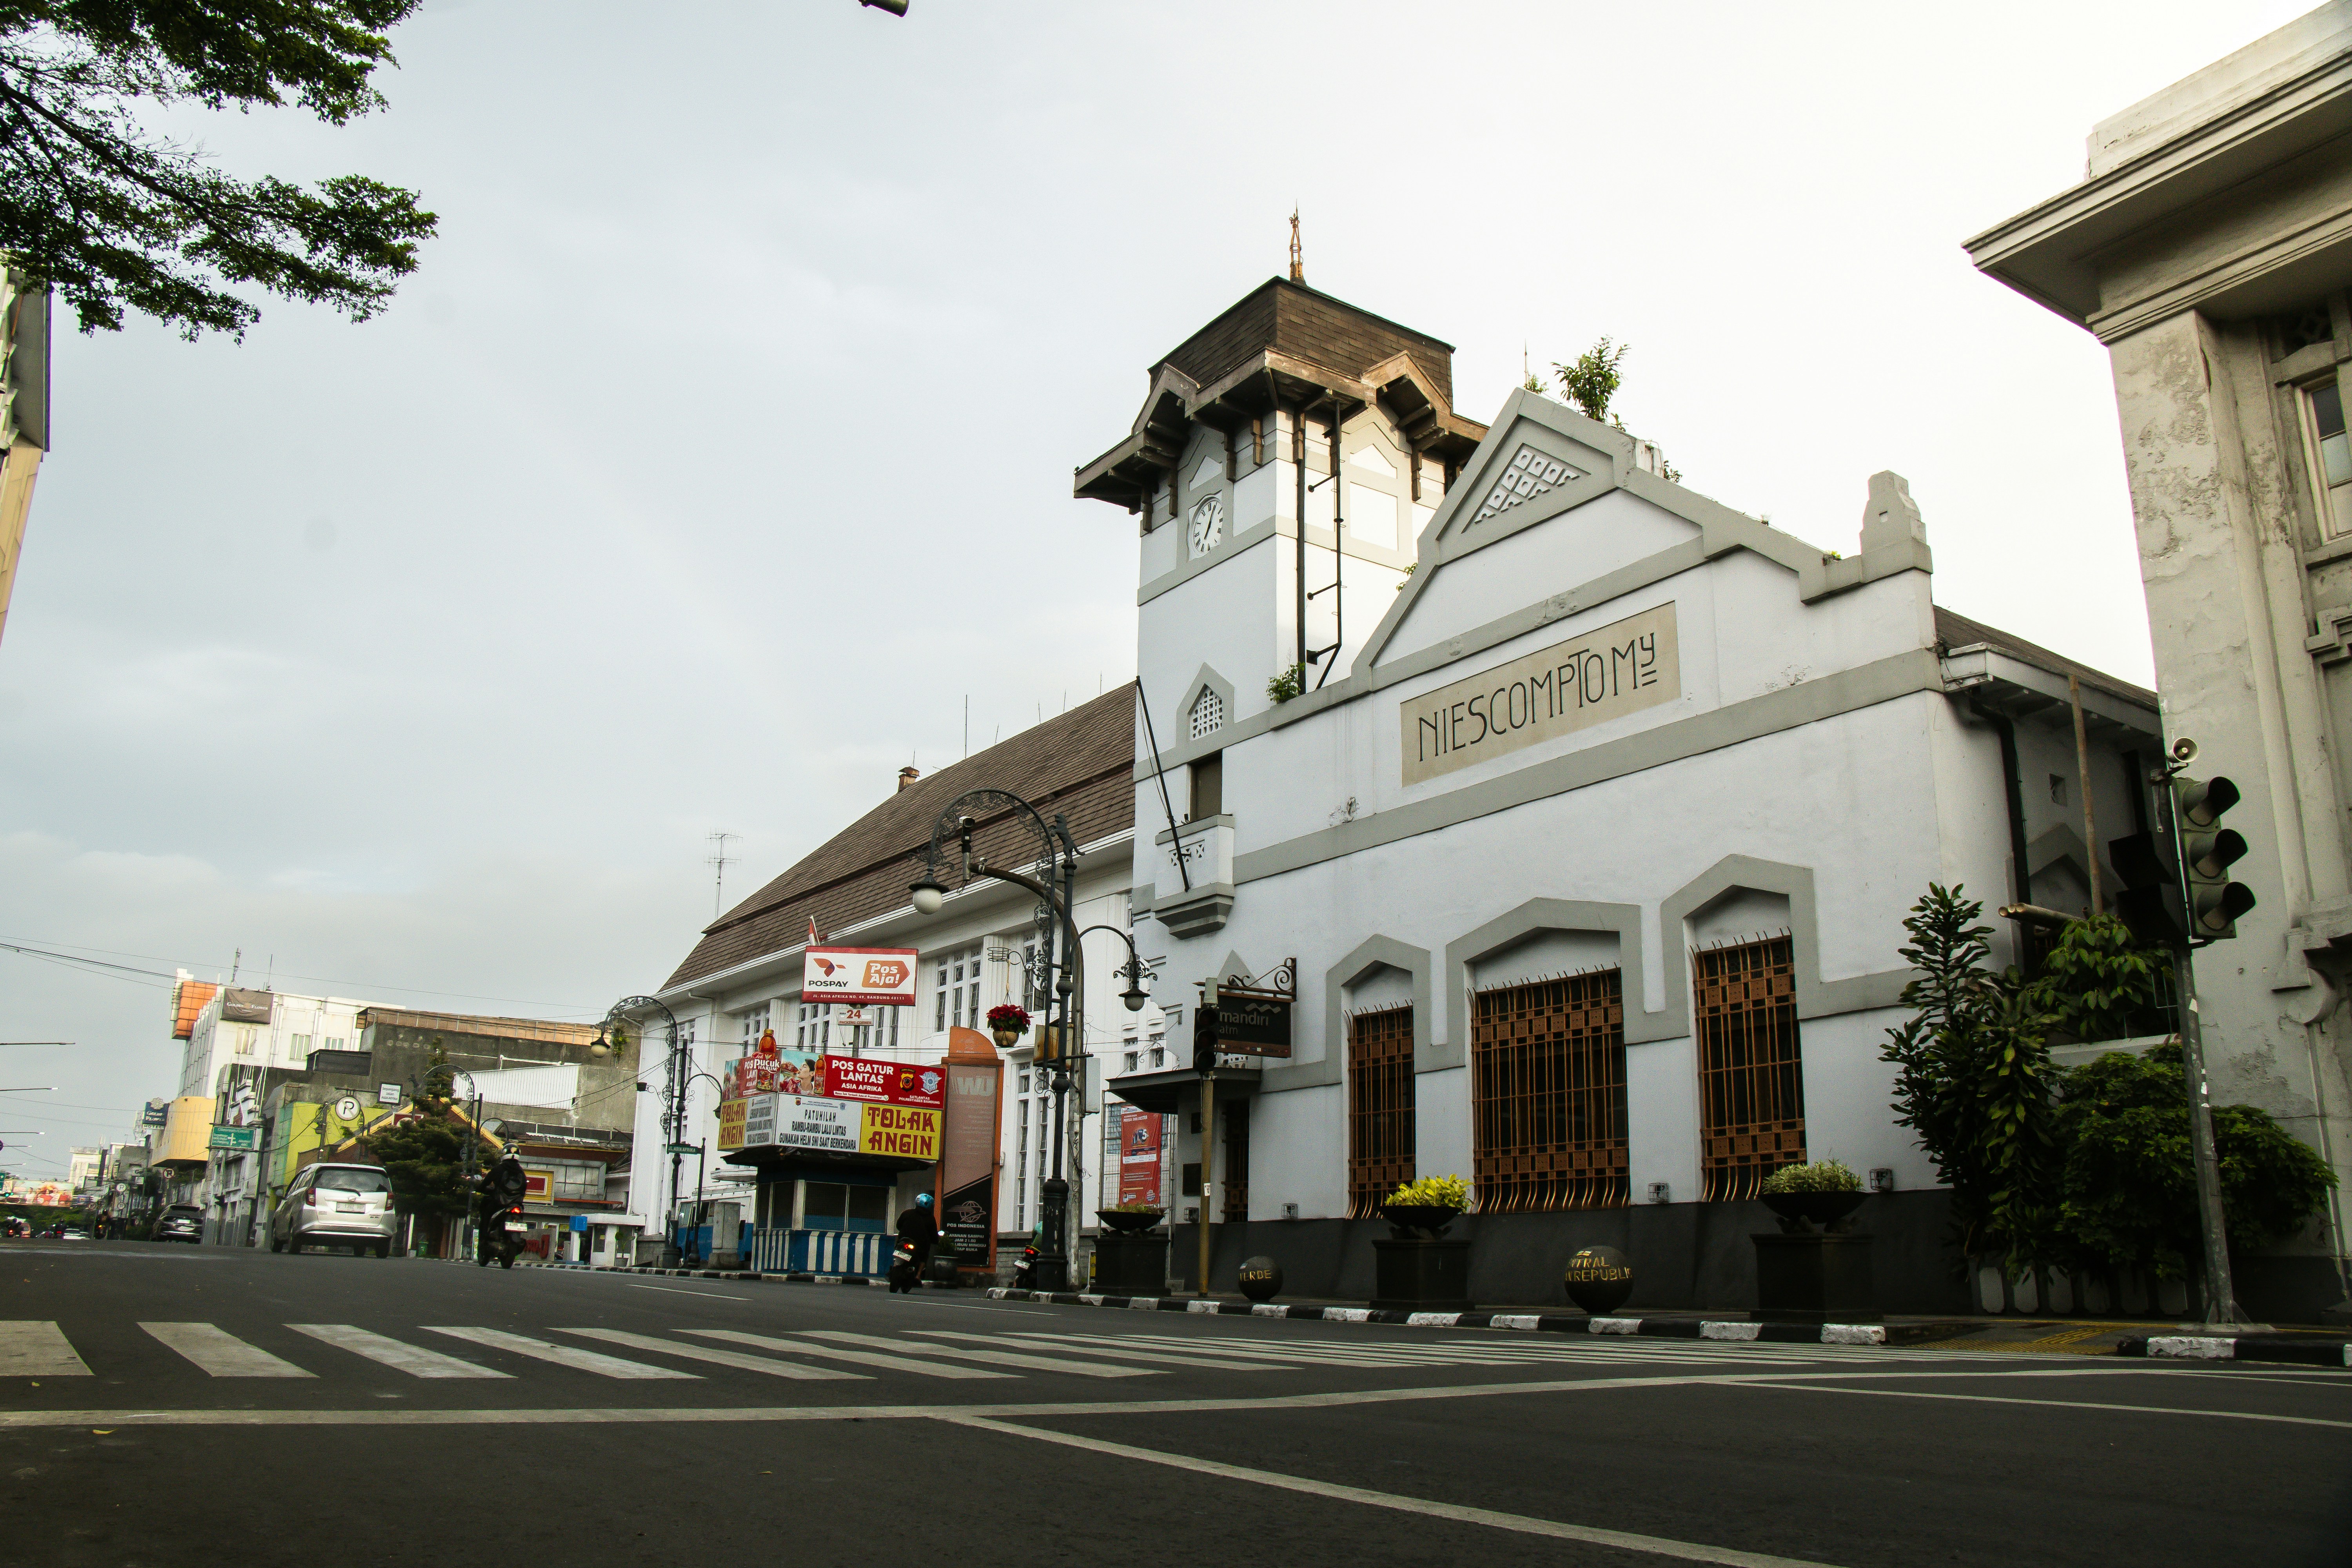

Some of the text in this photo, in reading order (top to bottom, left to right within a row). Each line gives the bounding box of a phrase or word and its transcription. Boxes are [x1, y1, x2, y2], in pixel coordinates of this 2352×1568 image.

[869, 963, 898, 974] Pos
[869, 973, 900, 986] Aja!
[846, 1009, 861, 1019] 24
[1220, 1011, 1269, 1026] mandiri
[1219, 1025, 1238, 1034] atm
[744, 1060, 753, 1070] POS
[753, 1058, 780, 1069] pucuk
[831, 1060, 893, 1075] POS GATUR
[840, 1071, 884, 1084] LANTAS
[858, 1084, 882, 1093] AFRIKA
[722, 1102, 746, 1123] TOLAK
[804, 1109, 836, 1123] PATUHILAH
[867, 1106, 936, 1133] TOLAK
[720, 1125, 744, 1146] ANGIN
[791, 1121, 846, 1136] RAMBU-RAMBU LALU LINTAS
[779, 1132, 799, 1145] GUNAKAN
[799, 1134, 811, 1145] HELM
[819, 1137, 830, 1147] SAAT
[830, 1137, 857, 1150] BERKENDARA
[868, 1131, 933, 1156] ANGIN
